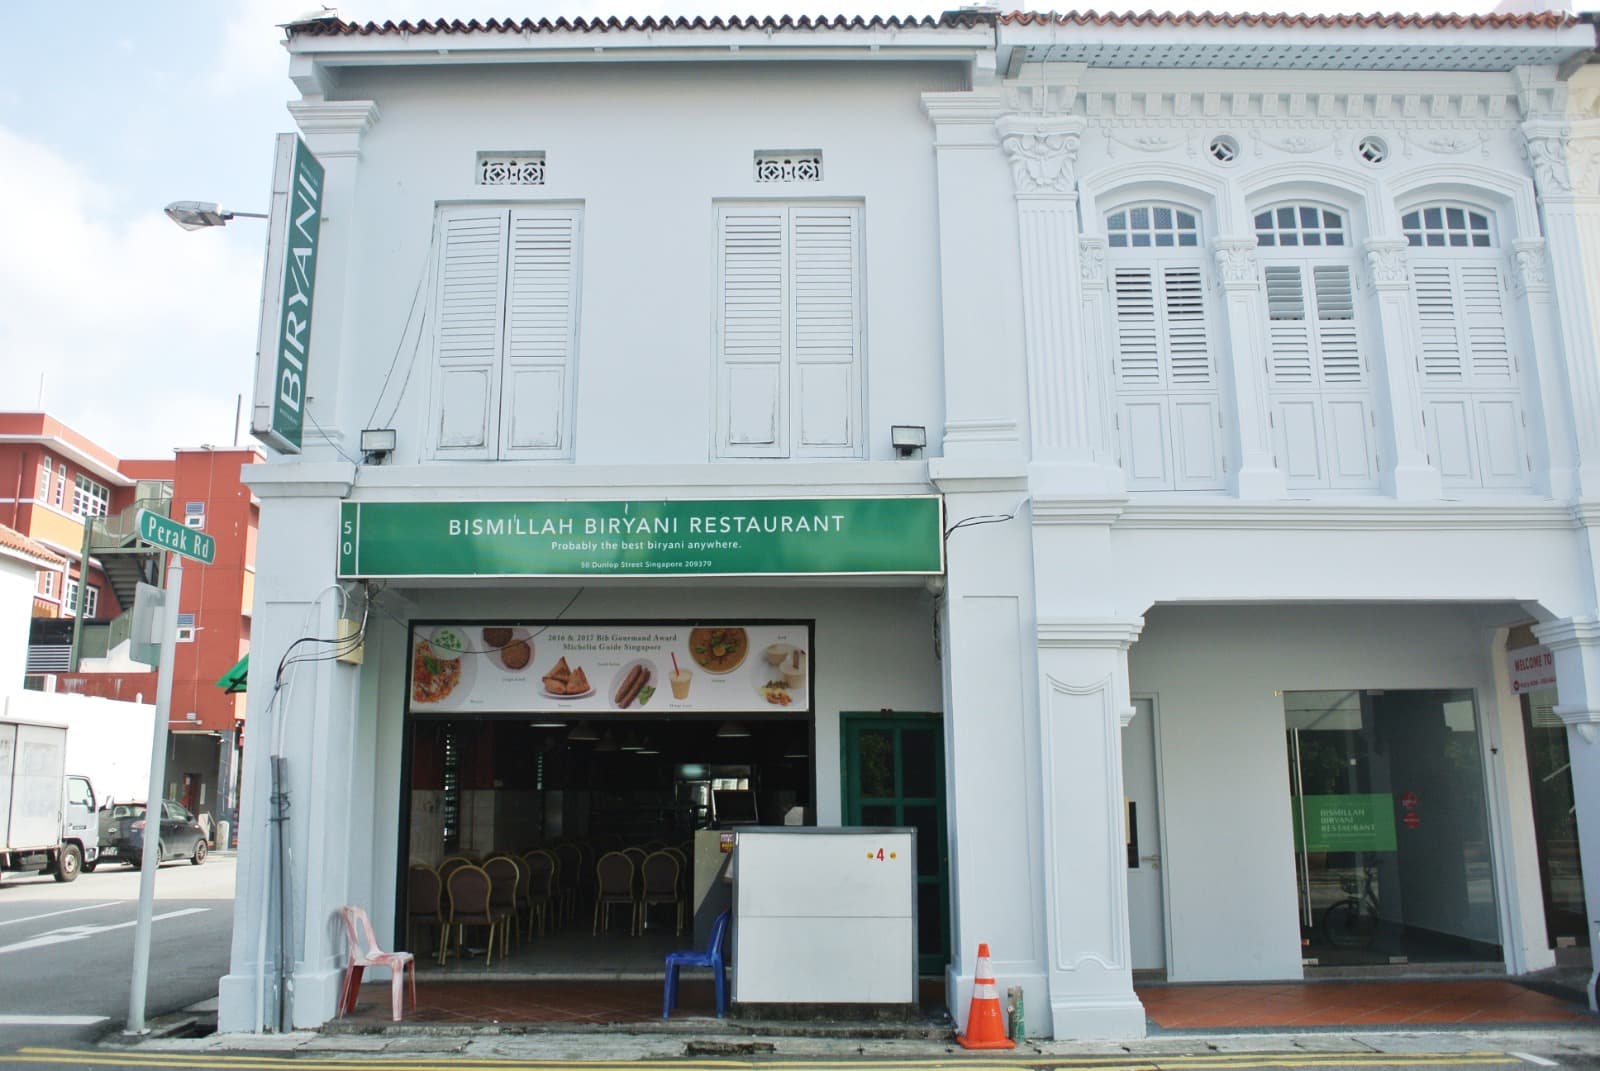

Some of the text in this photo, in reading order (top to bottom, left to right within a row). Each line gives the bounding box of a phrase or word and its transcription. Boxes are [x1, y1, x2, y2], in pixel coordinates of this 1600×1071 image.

[281, 173, 318, 412] BIRYANI
[449, 515, 845, 535] BISMILLAH BIRYANI RESTAURANT
[148, 516, 209, 558] Perak Rd
[551, 540, 742, 551] Probably the best biryani anywhere.
[592, 561, 619, 569] Dunlop
[645, 560, 683, 569] Singapore
[611, 634, 651, 642] Gourmand
[654, 633, 677, 641] Award
[563, 642, 661, 652] Michelin Guide Singapore
[1514, 652, 1552, 672] WELCOME TO
[1320, 808, 1365, 817] BISMILLAH
[1321, 824, 1376, 832] RESTAURANT
[876, 848, 885, 862] 4
